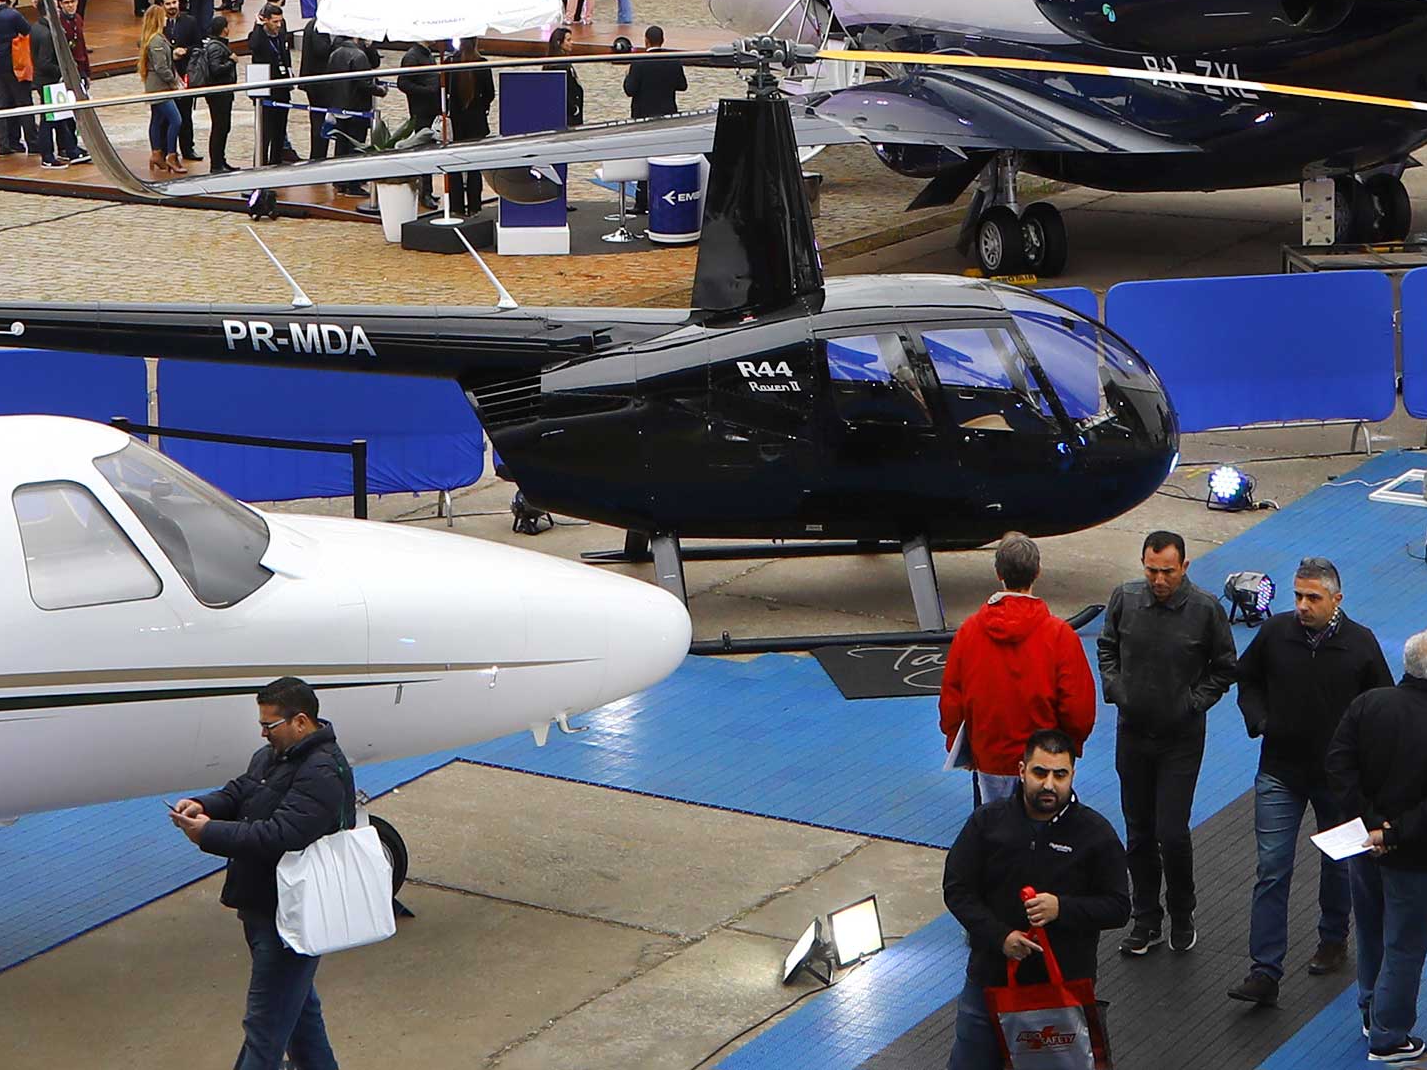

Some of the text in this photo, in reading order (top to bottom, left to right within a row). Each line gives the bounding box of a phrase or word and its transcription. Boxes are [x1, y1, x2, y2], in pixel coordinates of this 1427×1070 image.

[222, 319, 377, 357] PR-MDA
[736, 361, 793, 378] R44
[748, 380, 802, 392] Raven II
[1041, 1033, 1075, 1044] SAFETY
